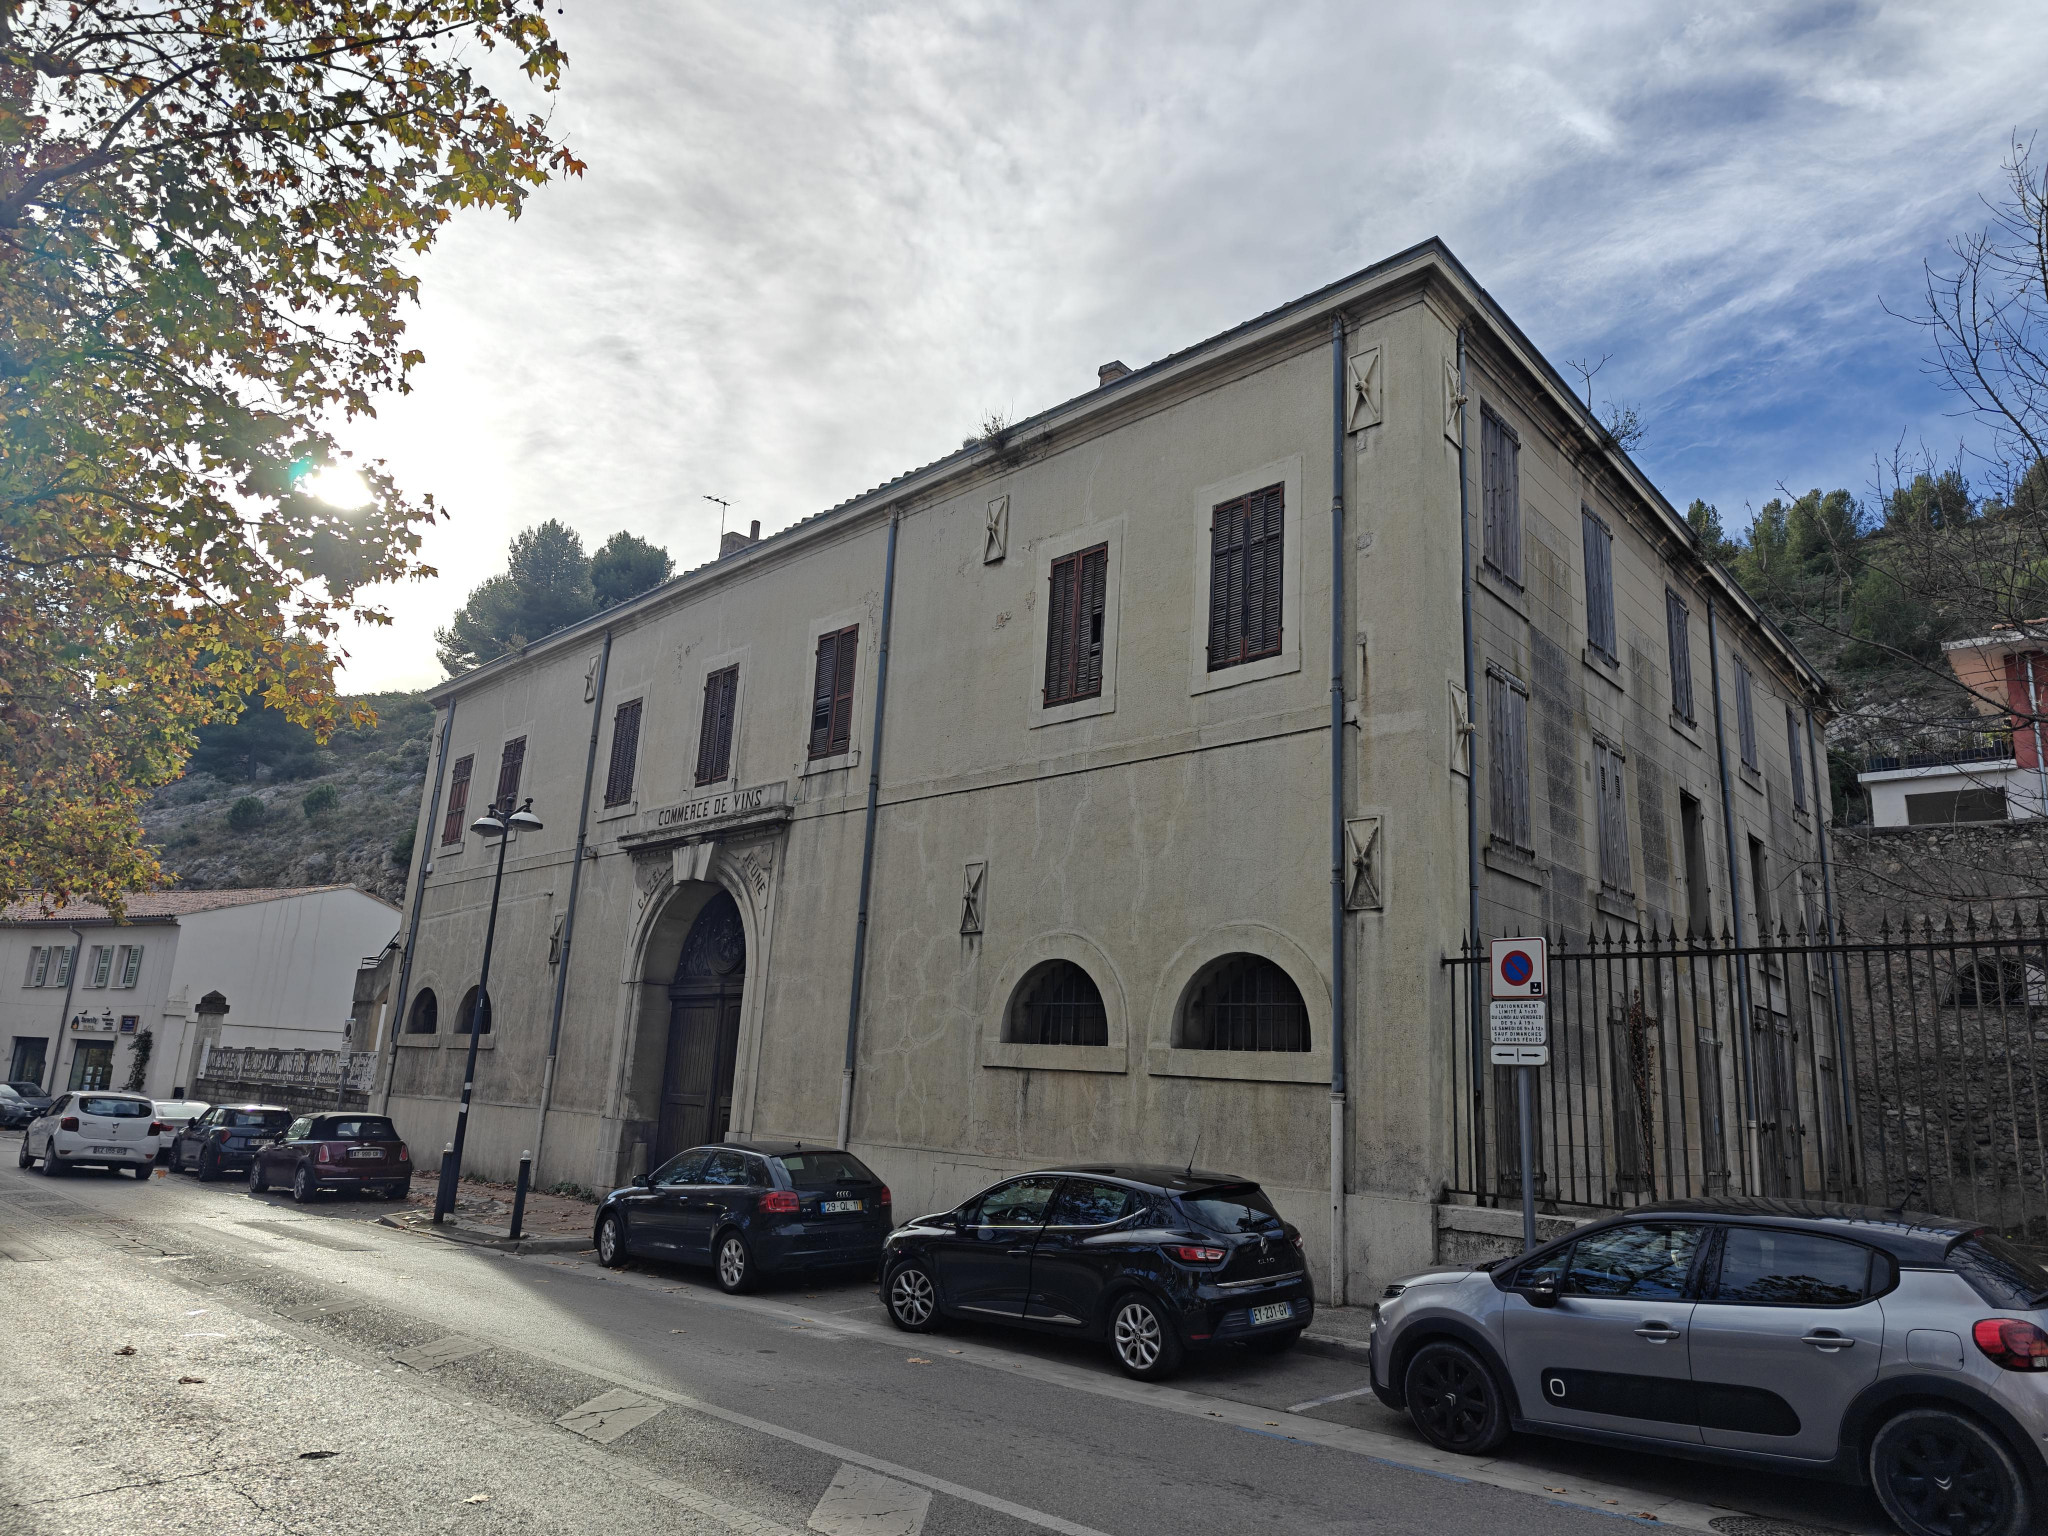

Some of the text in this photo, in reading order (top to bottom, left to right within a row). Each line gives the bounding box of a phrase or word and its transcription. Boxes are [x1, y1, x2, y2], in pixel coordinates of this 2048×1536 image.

[658, 789, 763, 826] COMMERCE DE VINS
[743, 852, 766, 896] JEUNE
[1253, 1303, 1288, 1322] EY-231-GV
